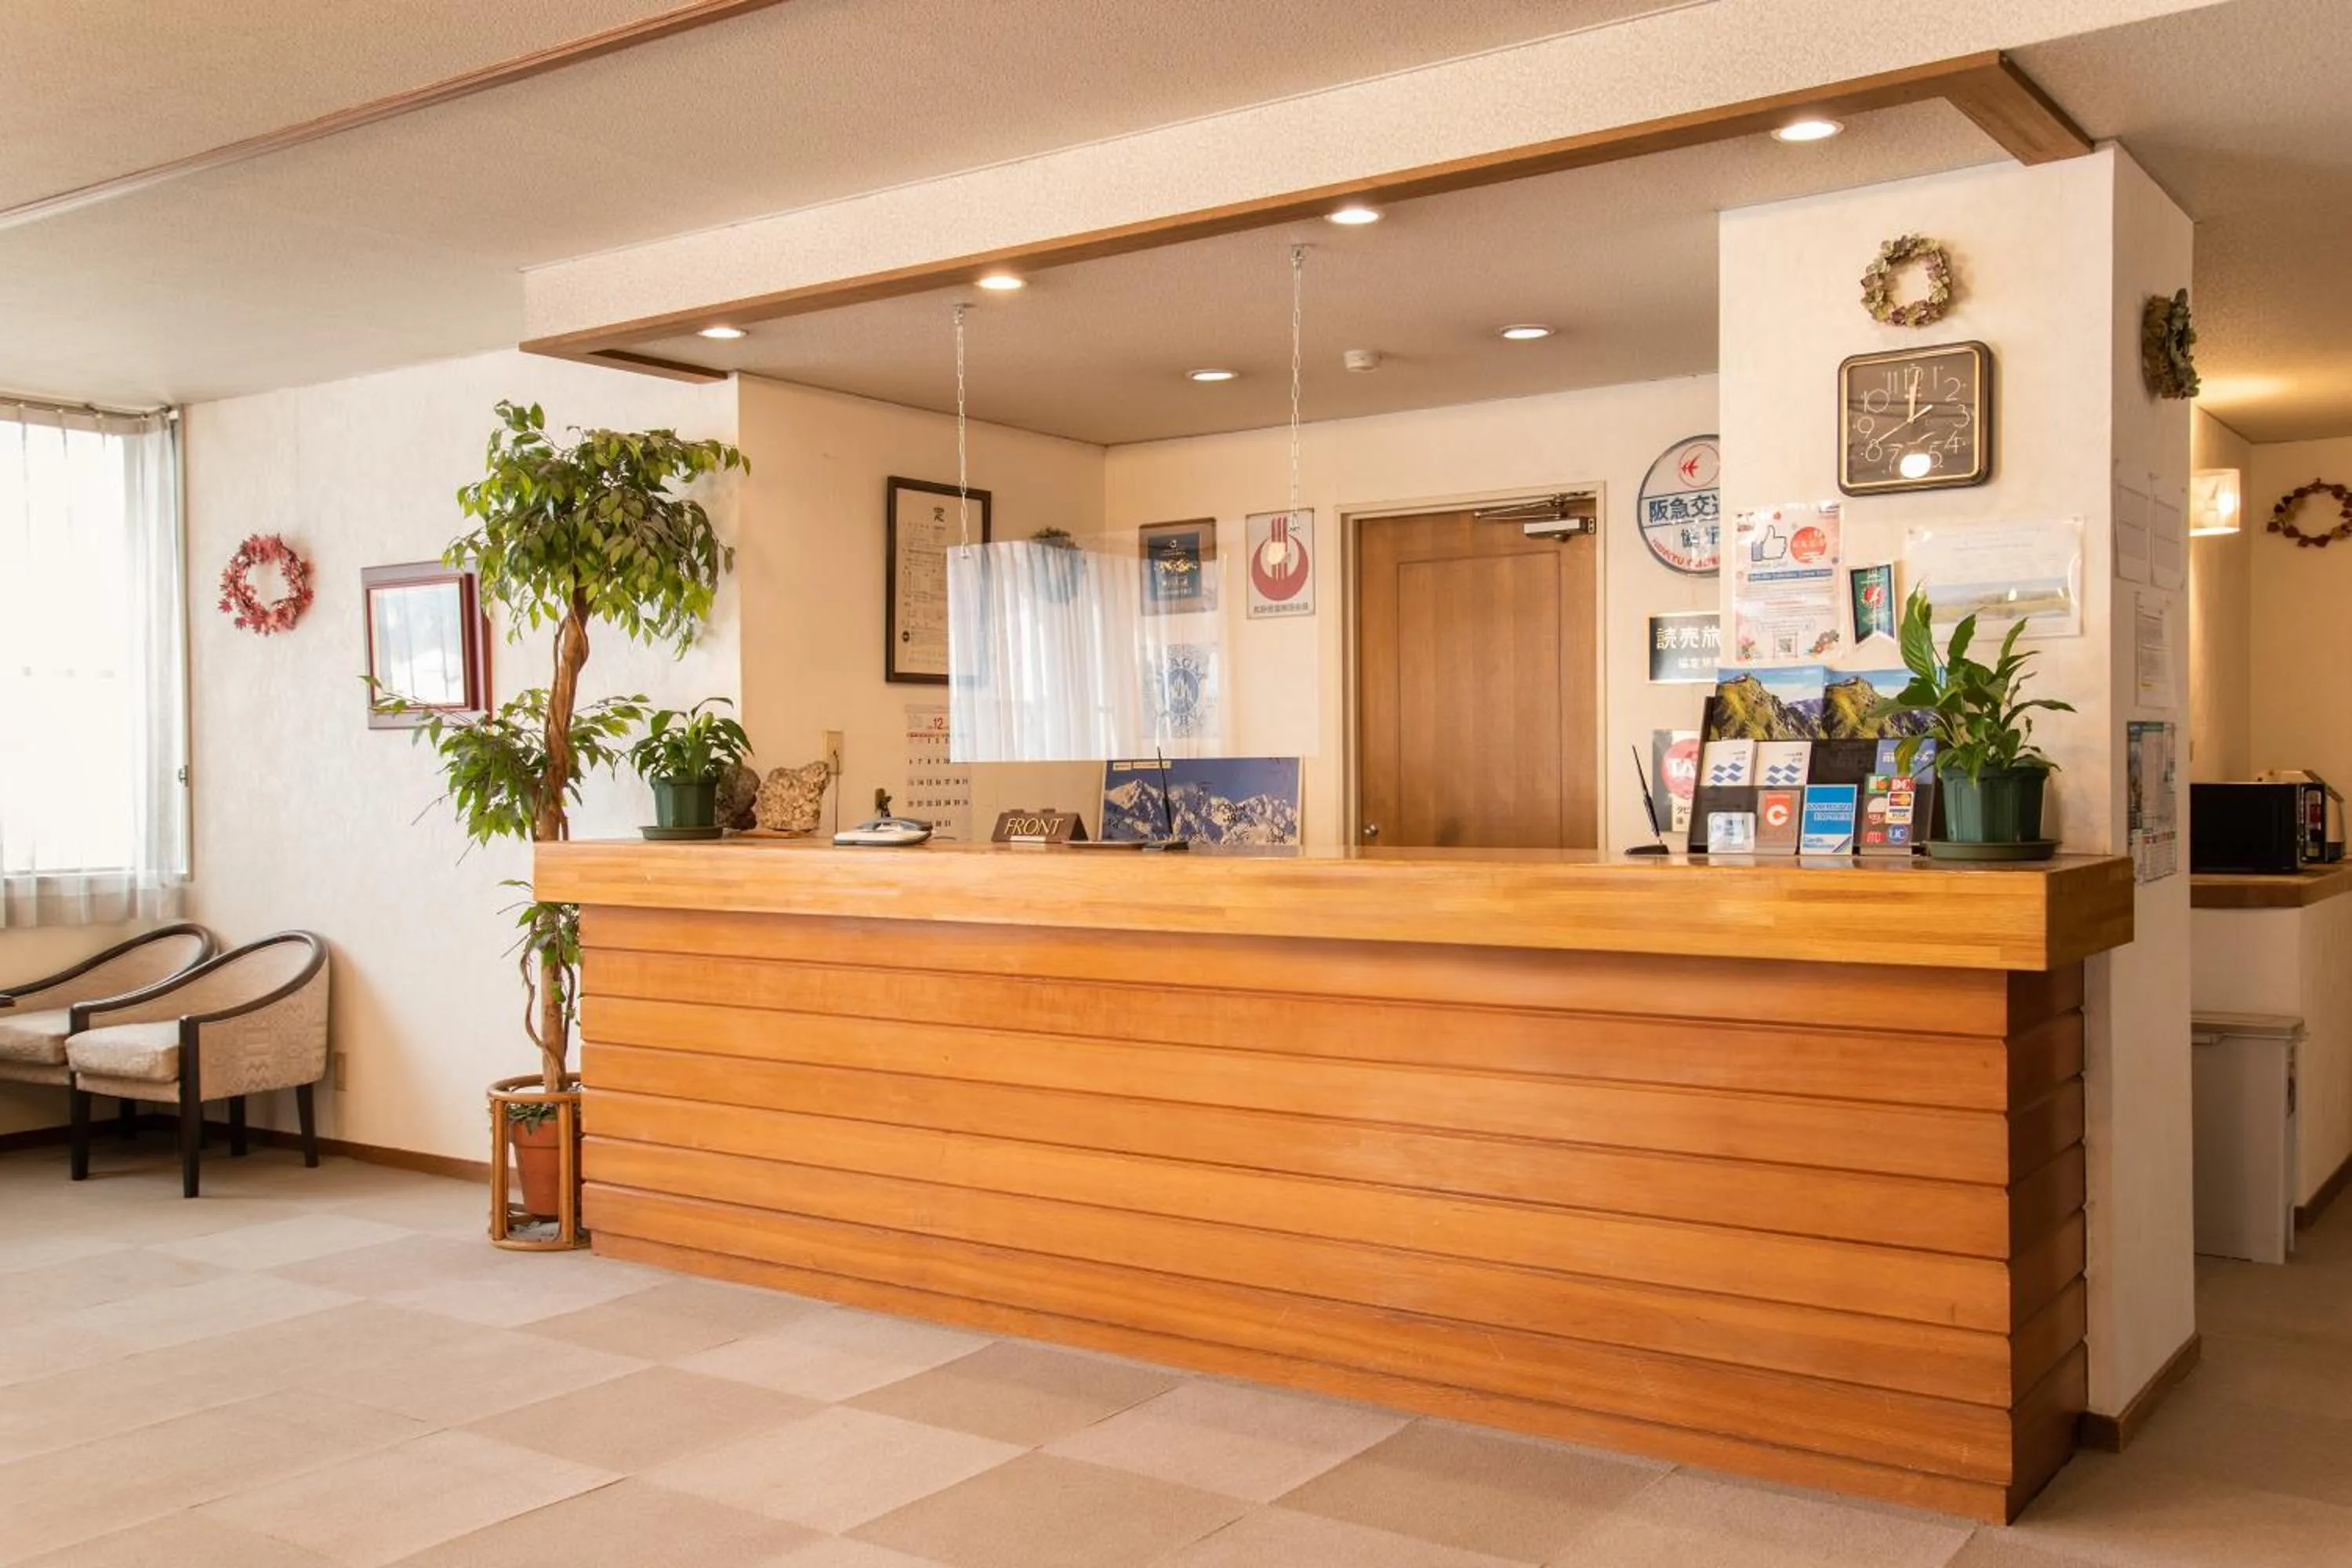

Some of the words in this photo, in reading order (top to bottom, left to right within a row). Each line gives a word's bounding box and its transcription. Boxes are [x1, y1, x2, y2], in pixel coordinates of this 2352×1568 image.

[1886, 372, 1897, 394] 11
[1944, 377, 1961, 401] 2
[1863, 388, 1889, 412] 10
[1952, 404, 1970, 427] 3
[1857, 417, 1875, 439] 9
[1865, 439, 1882, 462] 8
[1944, 430, 1964, 454] 4
[1928, 441, 1944, 468] 5
[933, 717, 943, 731] 12
[1004, 818, 1064, 835] FRONT
